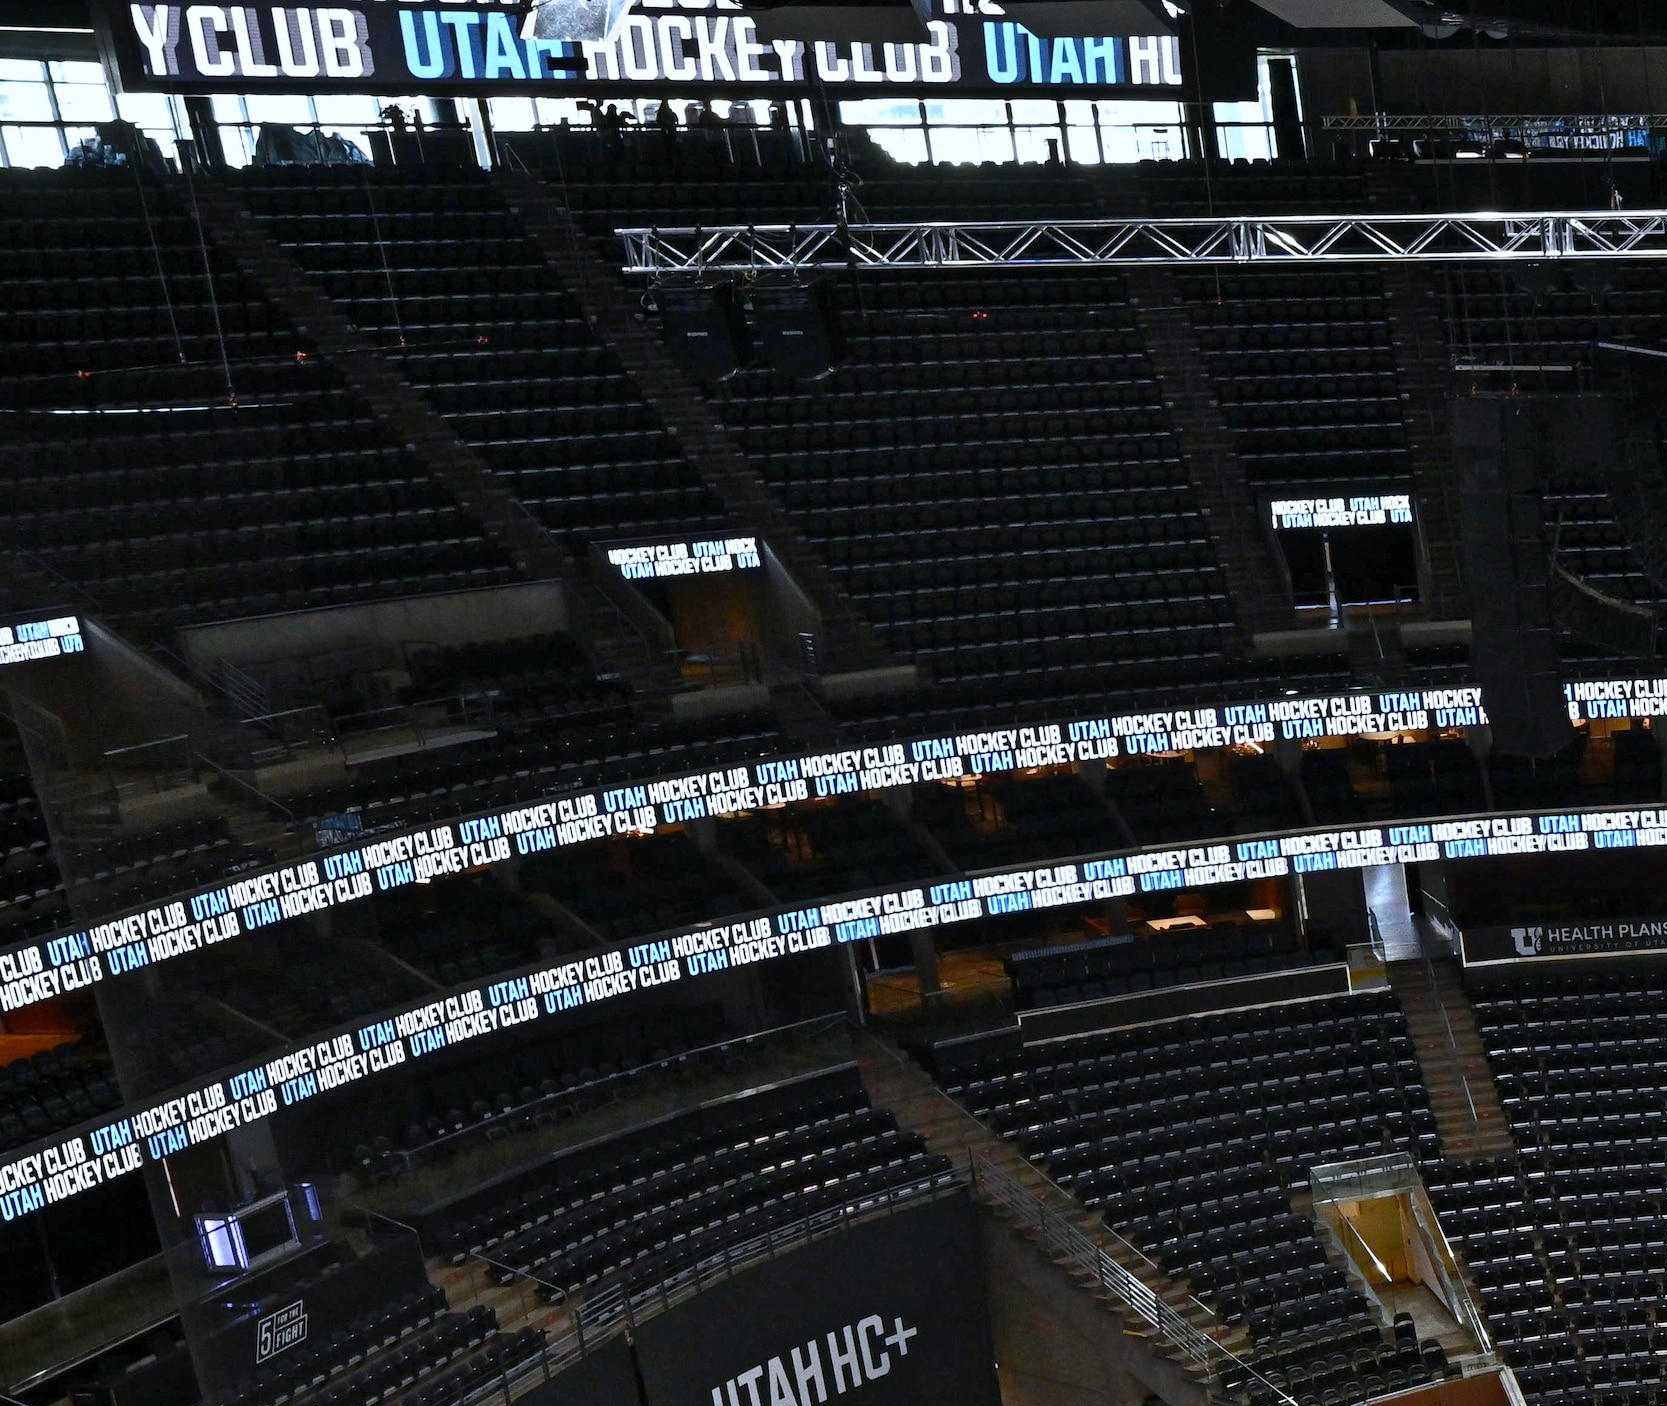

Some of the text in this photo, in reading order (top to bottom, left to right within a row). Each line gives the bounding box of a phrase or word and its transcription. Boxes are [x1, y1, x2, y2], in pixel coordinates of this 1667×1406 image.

[187, 5, 371, 78] CLUB
[656, 543, 688, 560] CLUB
[692, 541, 725, 557] UTAH
[1069, 709, 1217, 742] UTAH HOCKEY CLUB
[460, 795, 597, 844] UTAH HOCKEY CLUB
[1549, 925, 1613, 942] HEALTH
[1550, 941, 1619, 953] UNIVERSITY
[1626, 940, 1639, 948] OF
[488, 951, 624, 1006] UTAH HOCKEY CLUB
[277, 1313, 288, 1325] FOR
[289, 1306, 299, 1320] THE
[261, 1321, 271, 1355] 5
[276, 1321, 304, 1348] FIGHT
[831, 1314, 918, 1395] HC+
